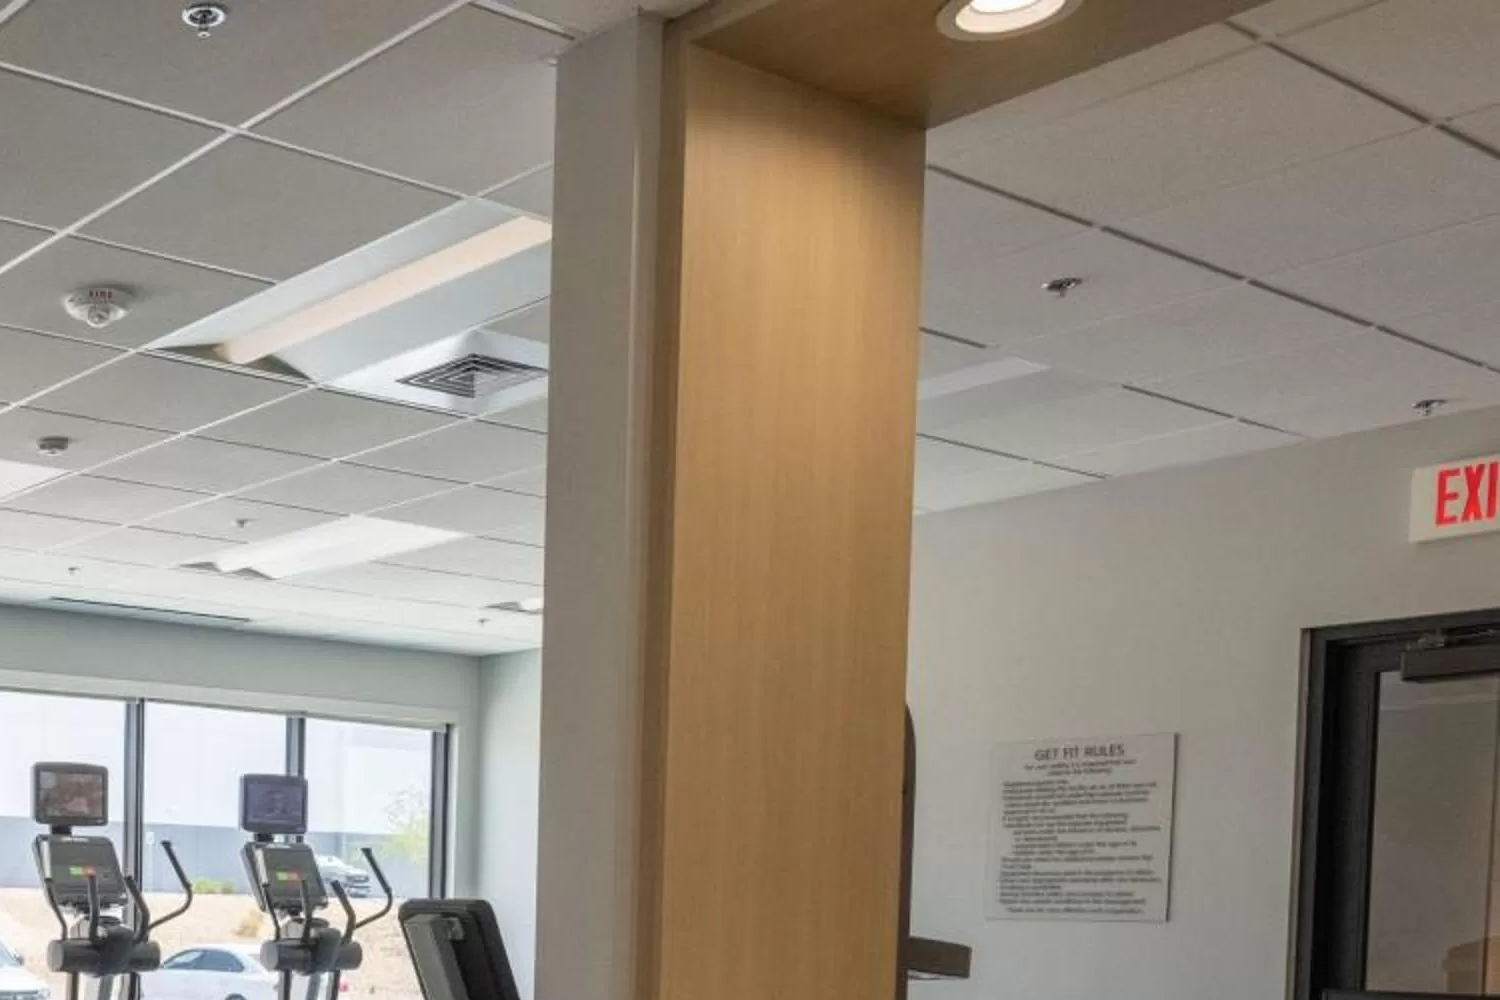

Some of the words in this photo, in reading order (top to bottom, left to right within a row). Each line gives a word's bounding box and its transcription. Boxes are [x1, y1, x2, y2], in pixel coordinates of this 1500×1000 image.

[1034, 748, 1058, 761] GET
[1063, 746, 1079, 759] FIT
[1084, 743, 1124, 757] RULES
